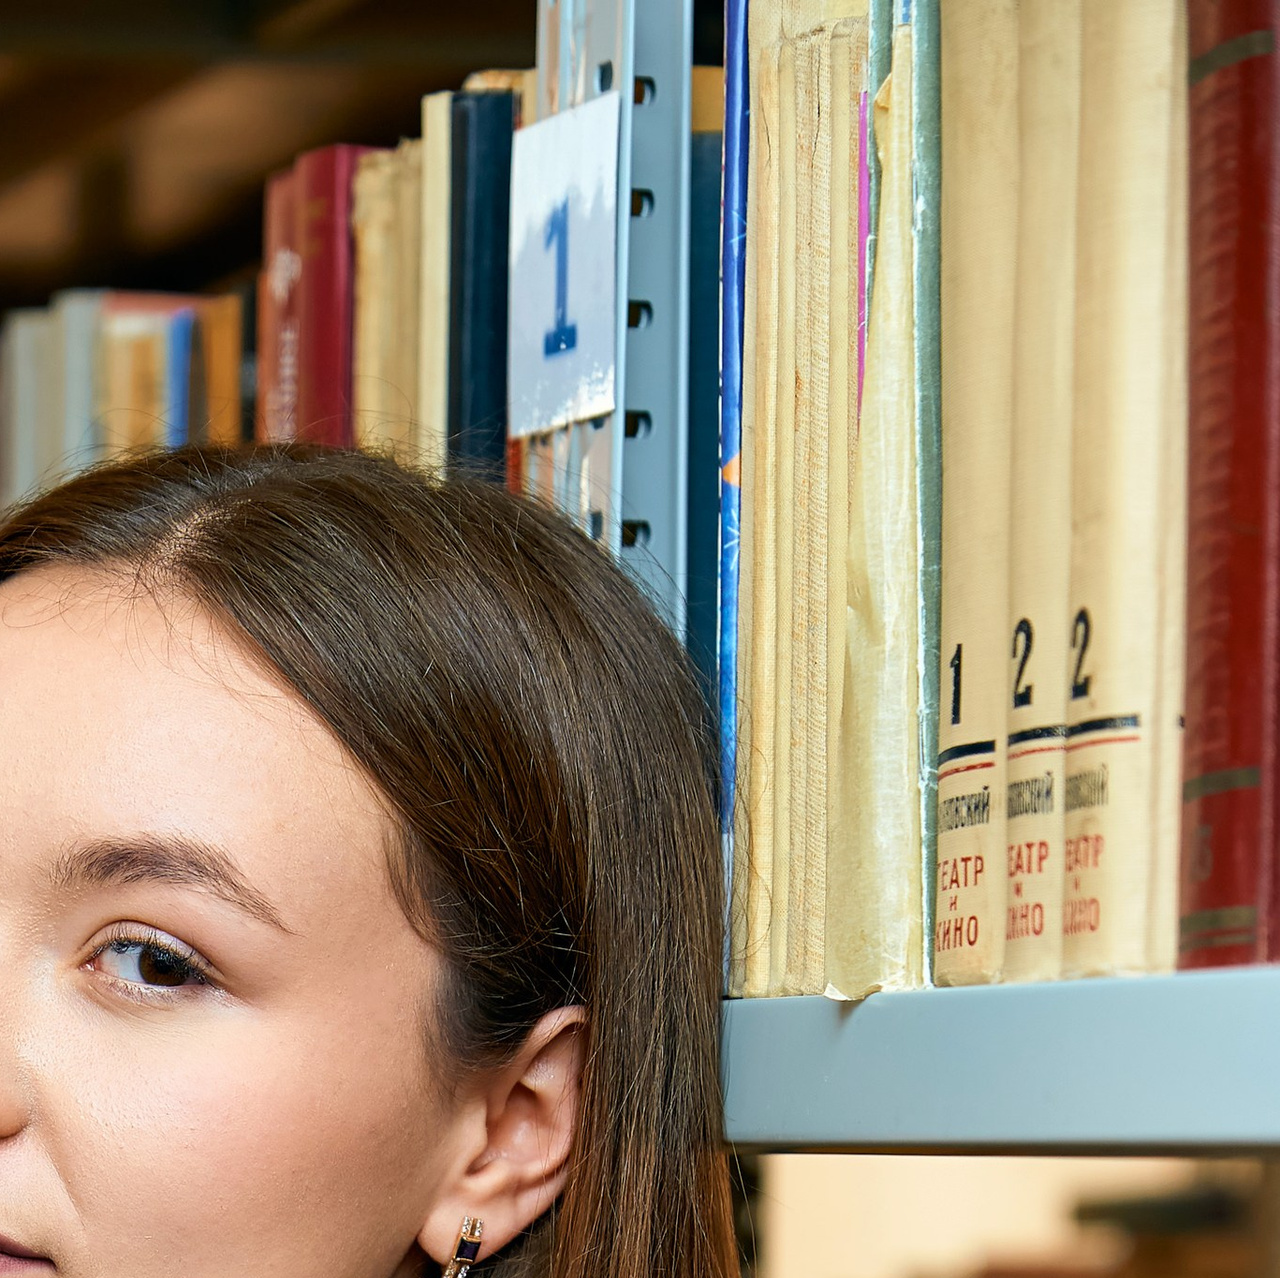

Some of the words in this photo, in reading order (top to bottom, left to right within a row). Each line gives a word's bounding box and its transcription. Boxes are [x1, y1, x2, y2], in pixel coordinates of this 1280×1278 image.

[543, 198, 577, 356] 1
[950, 643, 962, 725] 1
[1012, 618, 1034, 708] 2
[1071, 607, 1093, 699] 2
[1007, 840, 1049, 877] ЕАТР
